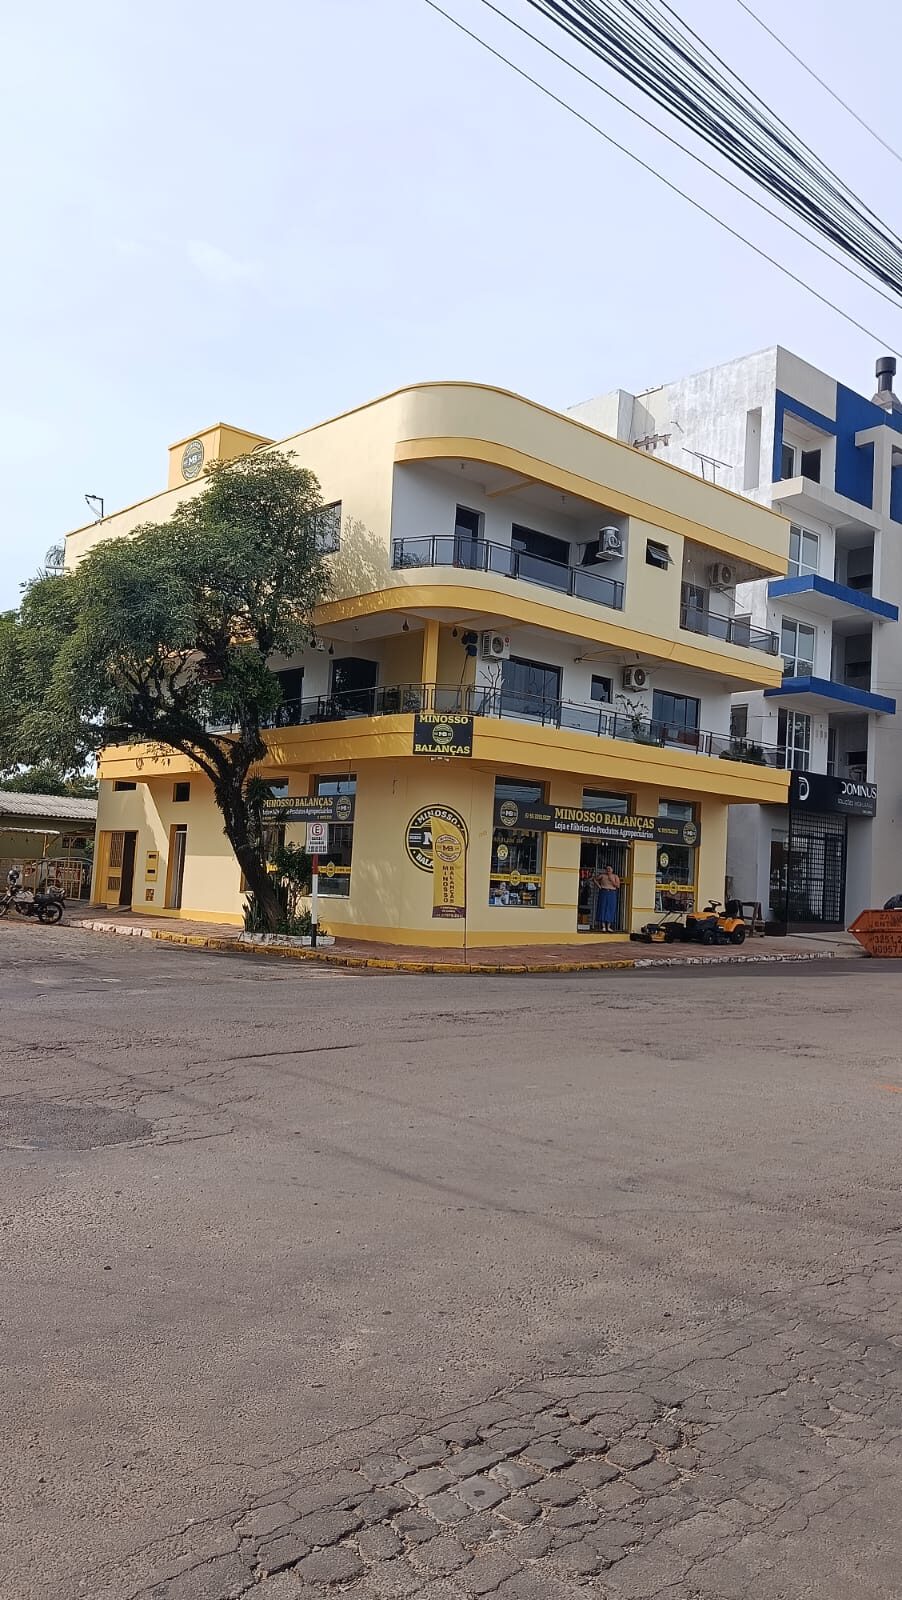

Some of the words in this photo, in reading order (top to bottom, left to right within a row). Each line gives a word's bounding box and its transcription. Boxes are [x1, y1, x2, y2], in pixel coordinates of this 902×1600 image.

[419, 714, 469, 724] MINOSSO
[415, 744, 470, 755] BALANÇAS
[841, 781, 877, 799] DOMINUS
[295, 797, 333, 808] BALANÇAS
[417, 810, 458, 825] MINOSSO
[554, 807, 603, 824] MINOSSO
[604, 813, 655, 831] BALANÇAS
[315, 825, 320, 833] E
[554, 821, 566, 831] Loja
[570, 822, 590, 833] Fábrica
[589, 824, 597, 833] de
[596, 826, 619, 836] Produtos
[619, 828, 654, 839] Agropecuários
